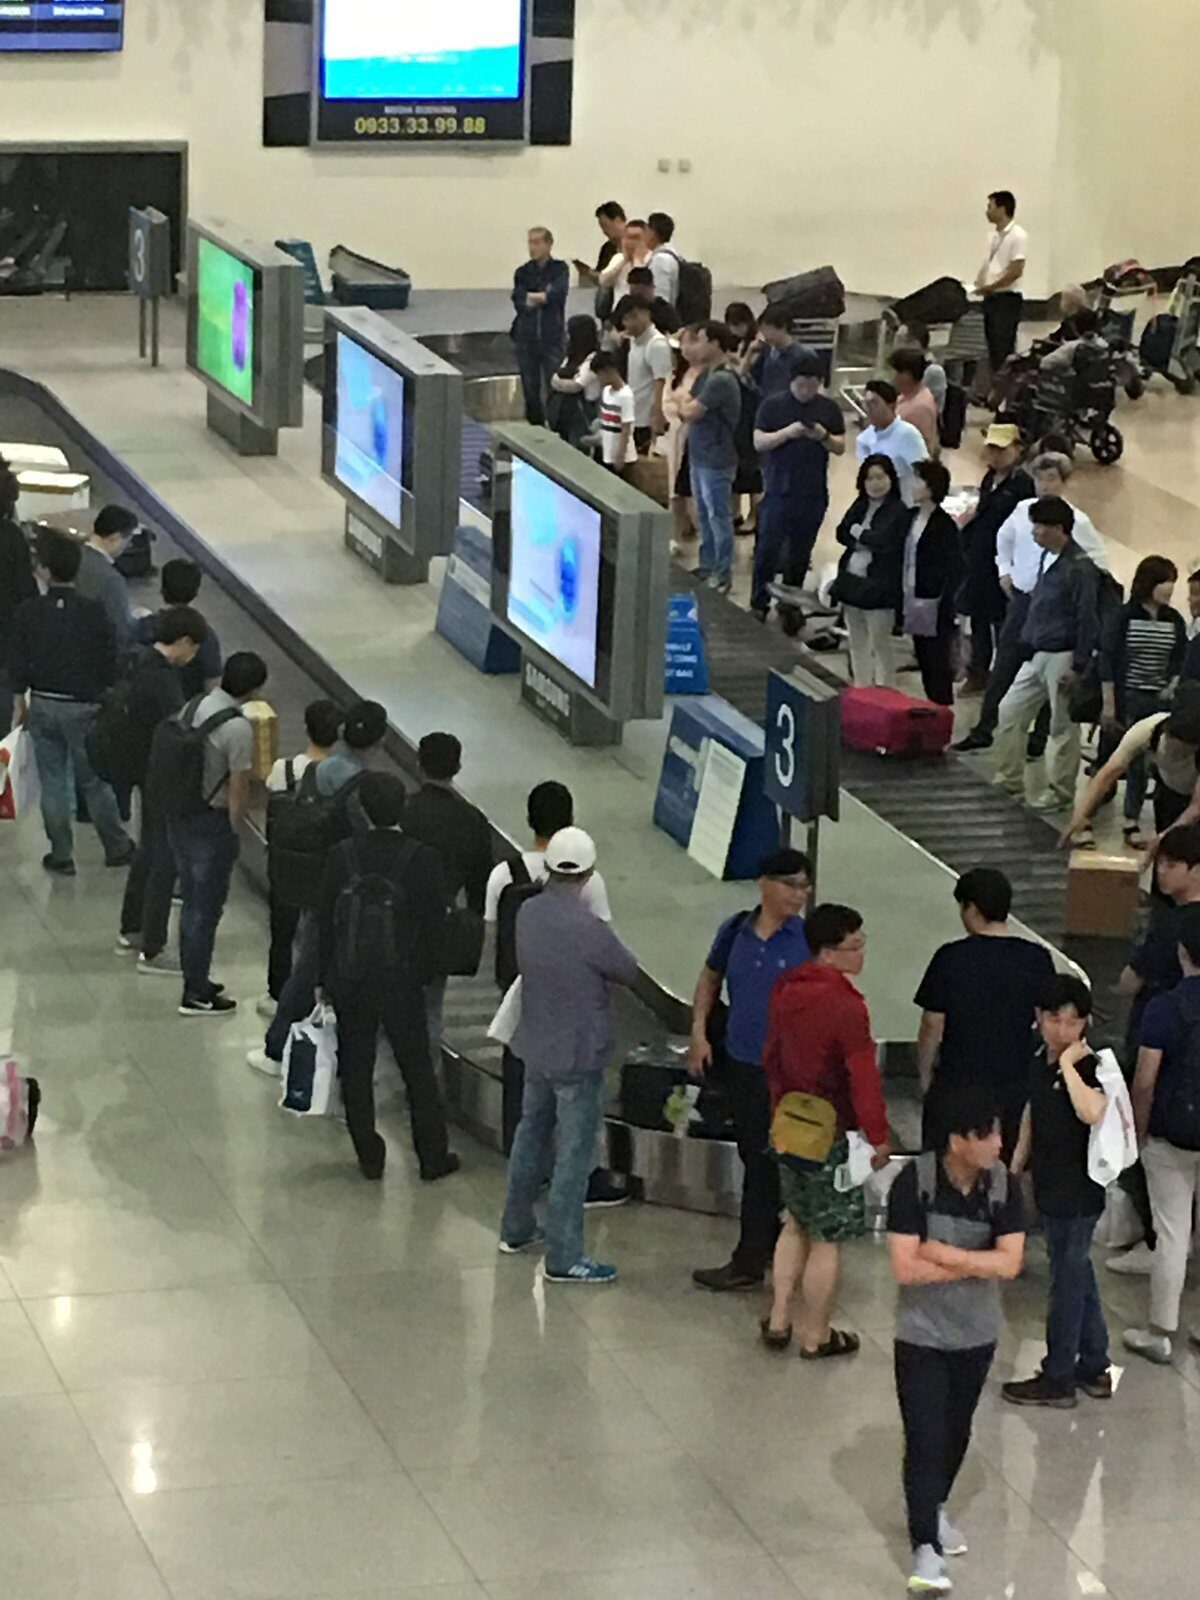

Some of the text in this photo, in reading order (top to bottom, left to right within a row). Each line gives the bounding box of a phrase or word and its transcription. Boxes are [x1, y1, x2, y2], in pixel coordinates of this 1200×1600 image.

[354, 117, 486, 134] 0933.33.99.88
[134, 229, 145, 282] 3
[775, 703, 795, 788] 3
